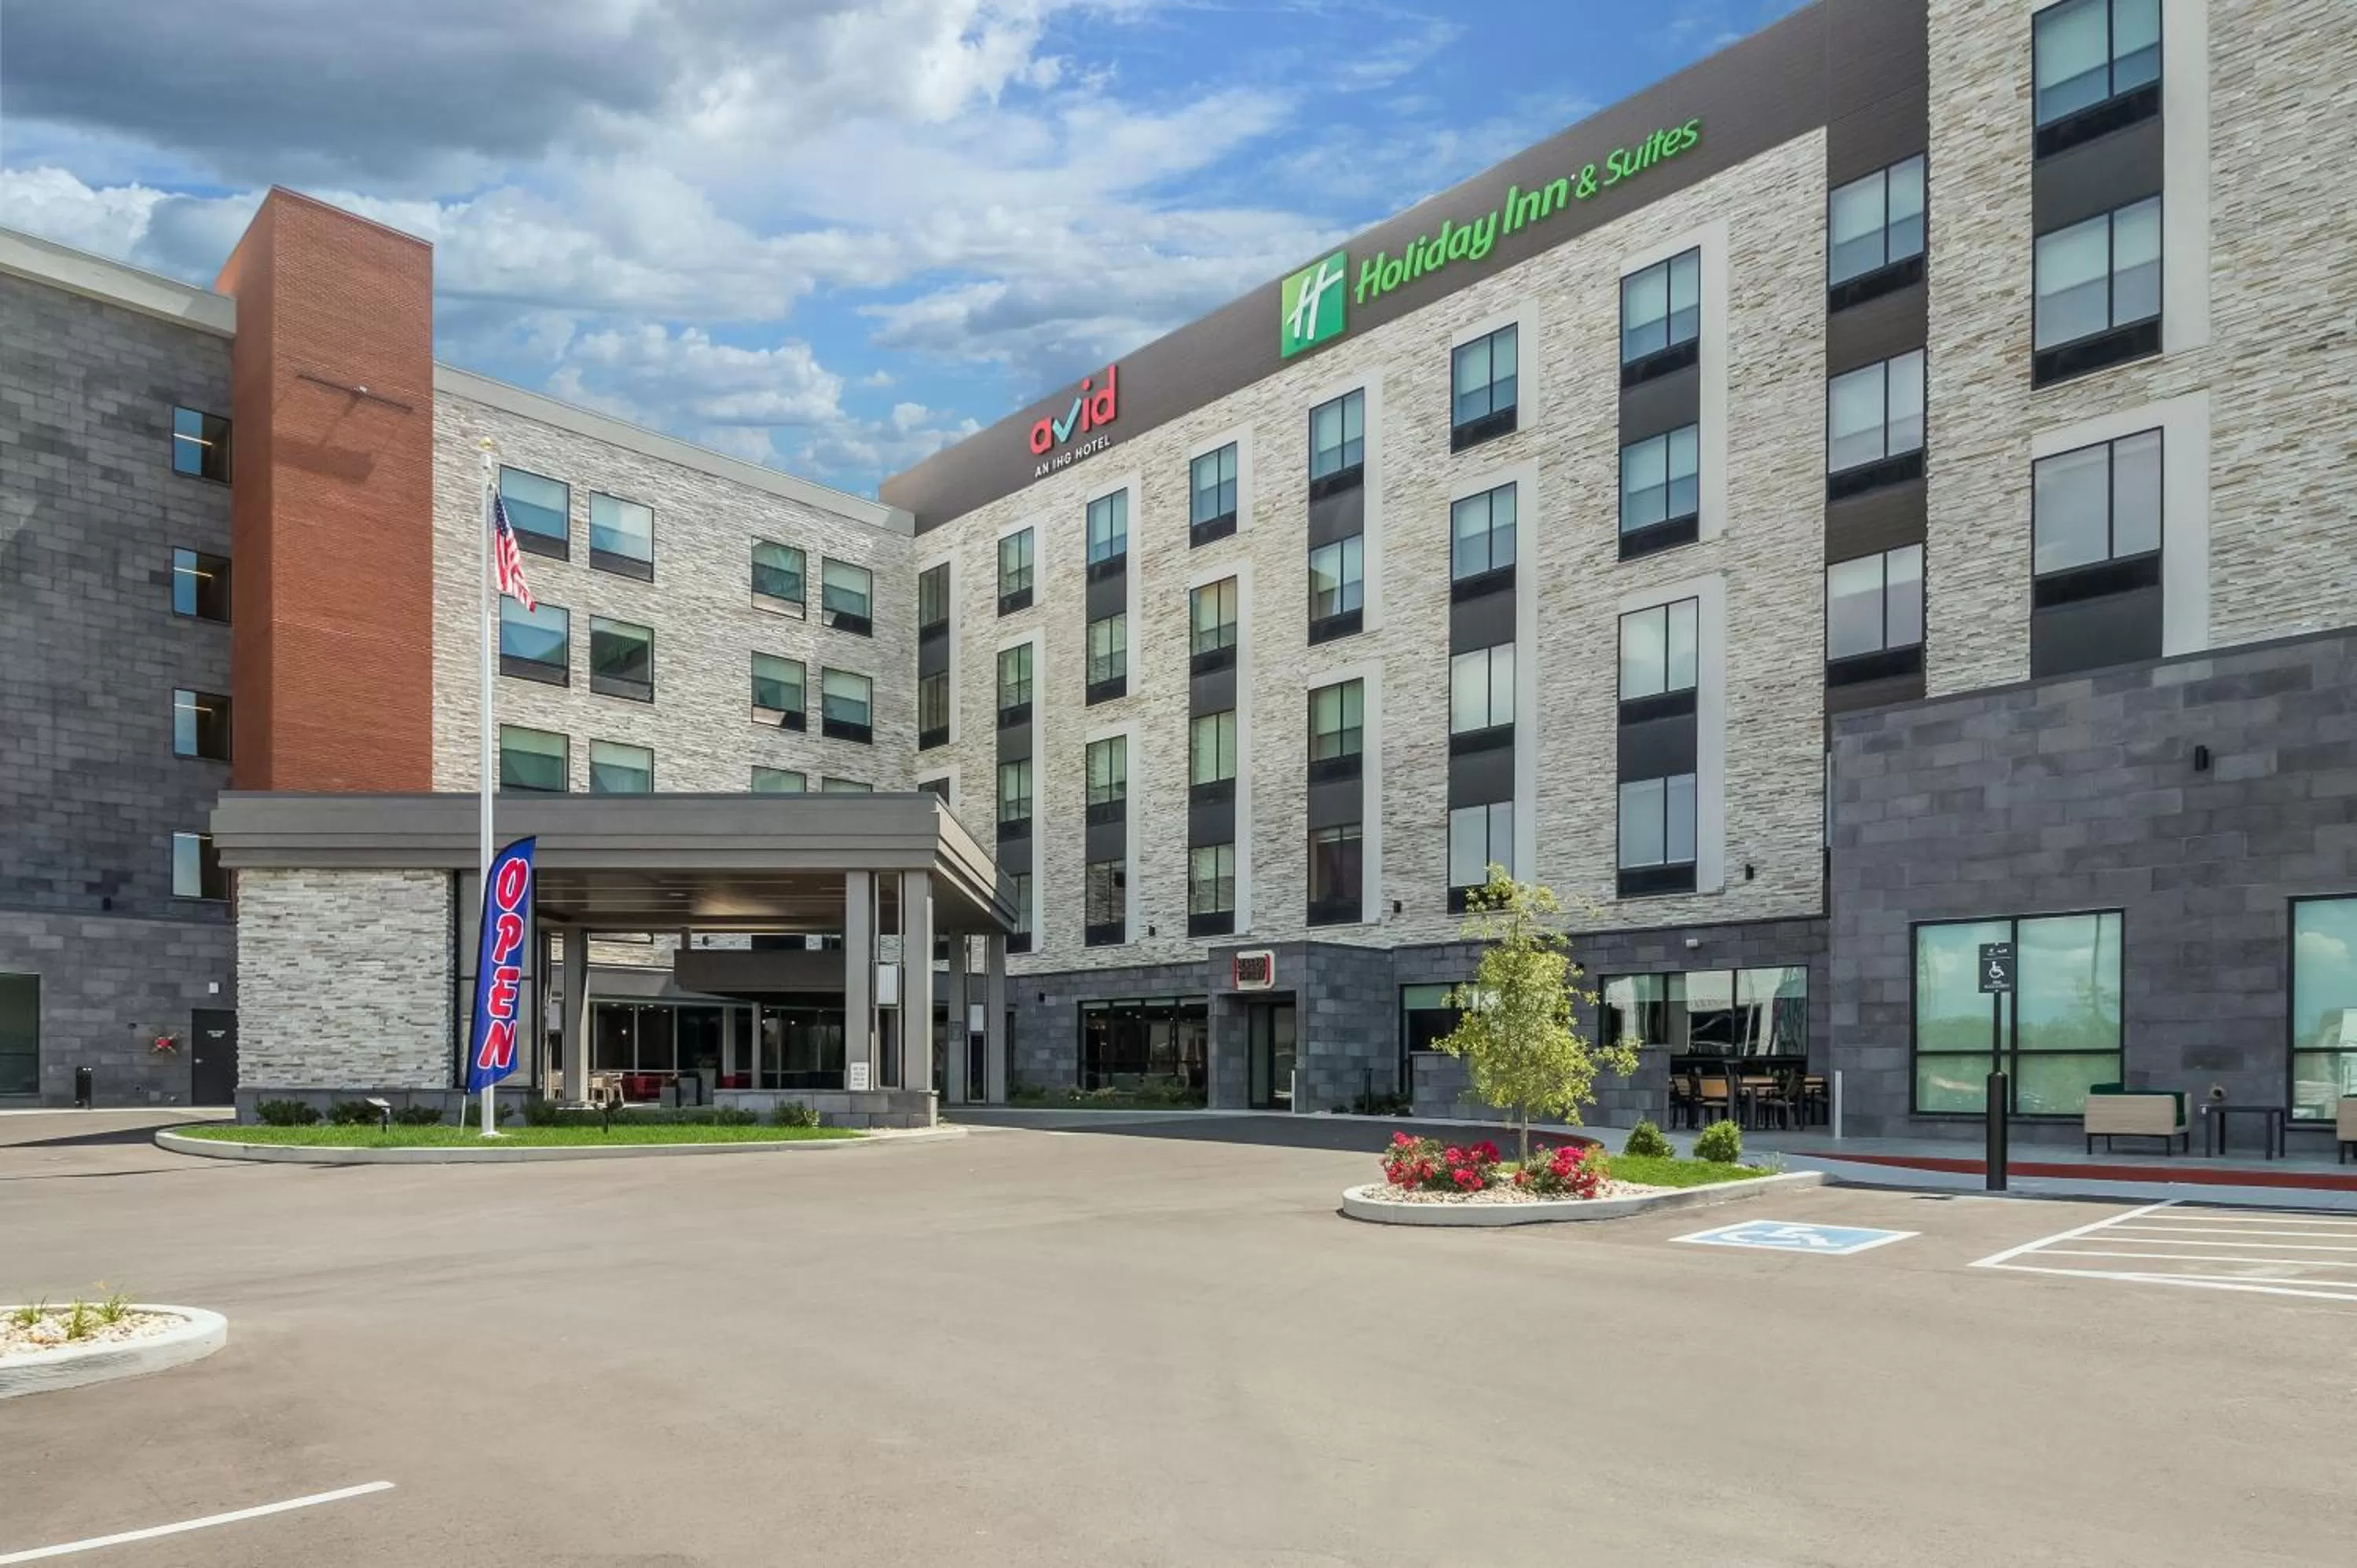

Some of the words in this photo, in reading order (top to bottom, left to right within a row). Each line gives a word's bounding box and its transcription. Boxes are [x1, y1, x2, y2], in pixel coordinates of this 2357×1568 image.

[1355, 211, 1497, 304] Holiday
[1502, 178, 1568, 234] Inn
[1575, 163, 1597, 198] &
[1603, 118, 1699, 186] Suites
[1030, 363, 1117, 454] avid
[1035, 461, 1049, 478] AN
[1052, 452, 1072, 470] IHG
[1076, 434, 1110, 460] HOTEL
[477, 857, 529, 1069] OPEN
